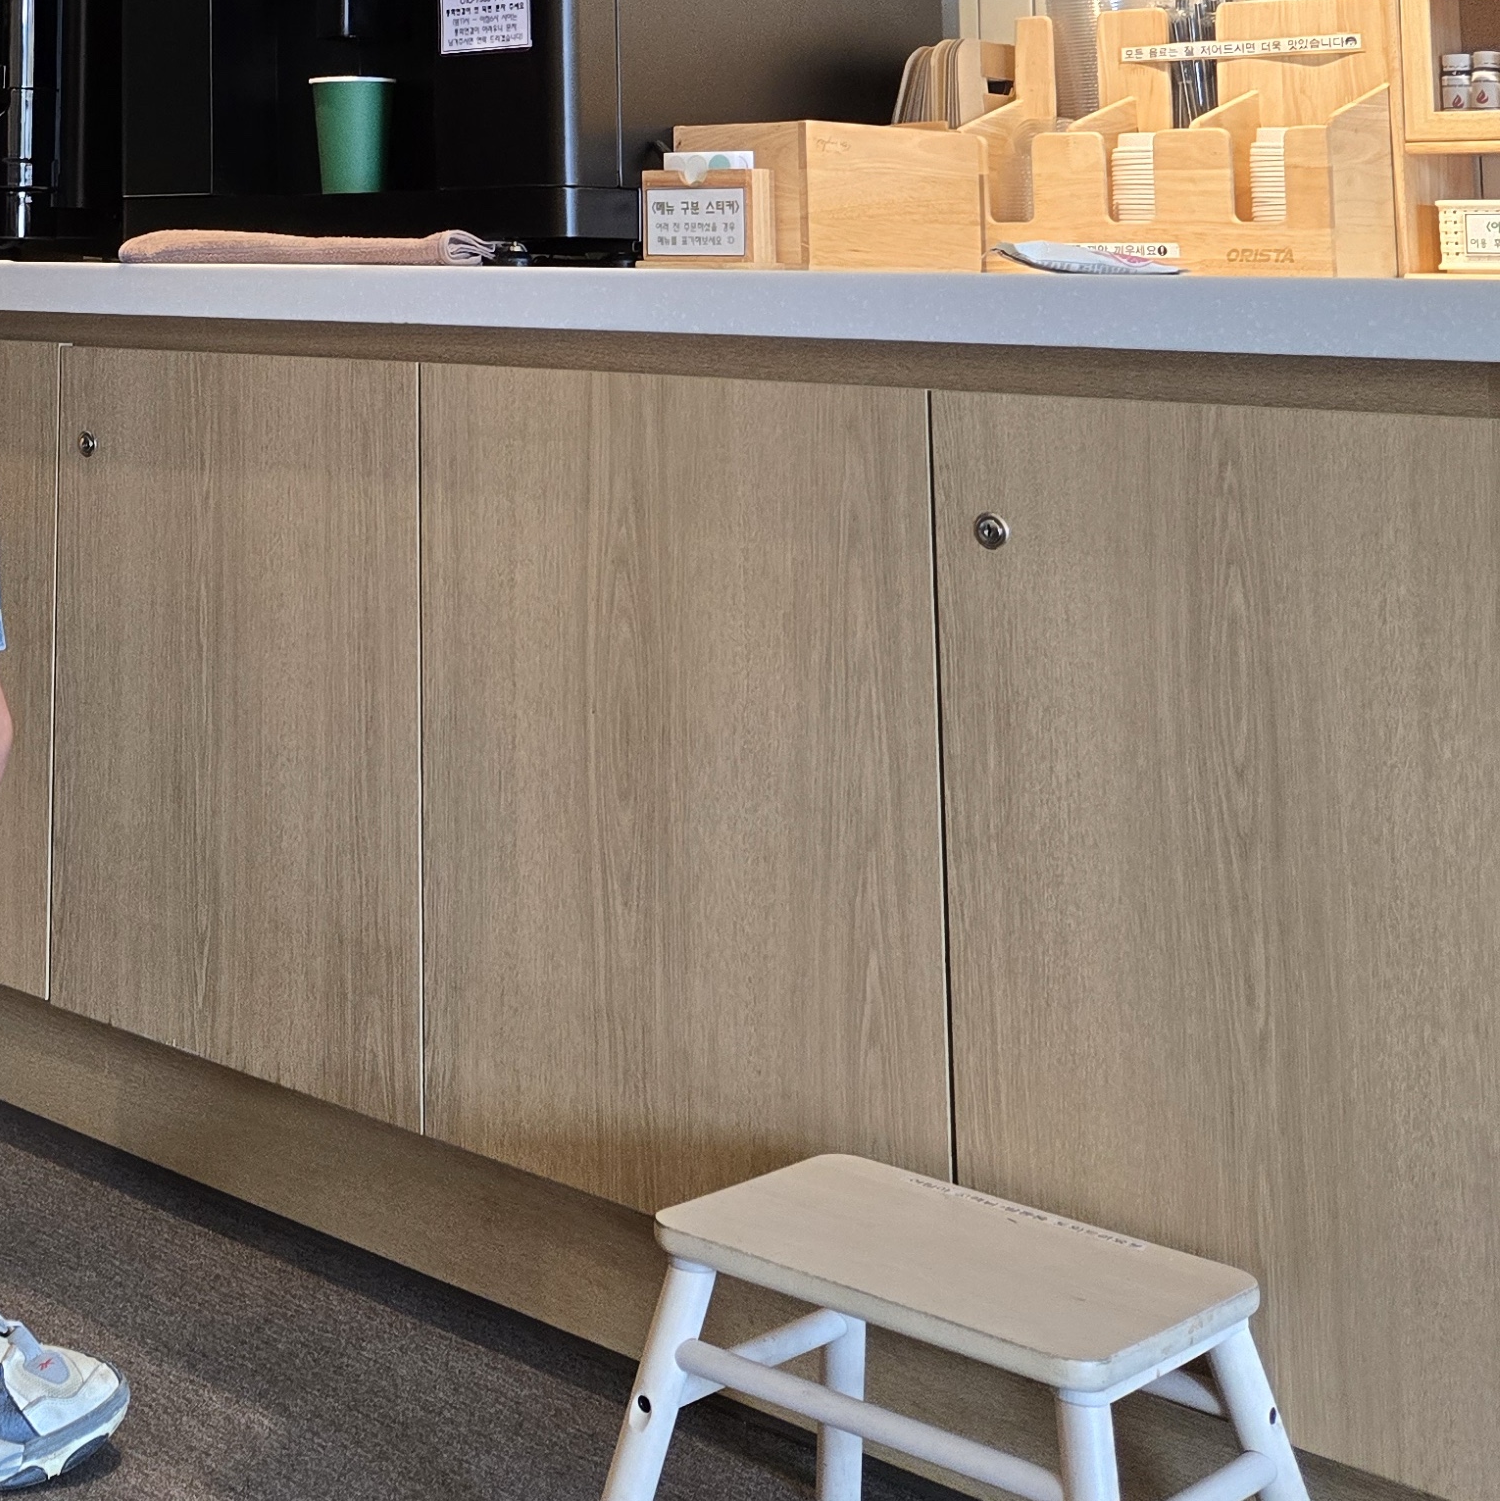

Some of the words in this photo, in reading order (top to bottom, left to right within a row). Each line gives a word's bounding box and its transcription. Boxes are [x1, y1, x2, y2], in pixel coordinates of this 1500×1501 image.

[1124, 49, 1143, 60] 모든
[1149, 47, 1179, 57] 음료는
[1184, 44, 1194, 56] 잘
[1200, 42, 1256, 55] 저어드시면
[1261, 41, 1281, 51] 더욱
[681, 201, 699, 215] 구분
[722, 221, 735, 232] 경우
[657, 236, 677, 245] 메뉴를
[1470, 238, 1487, 249] 이용
[1226, 248, 1296, 264] ORISTA
